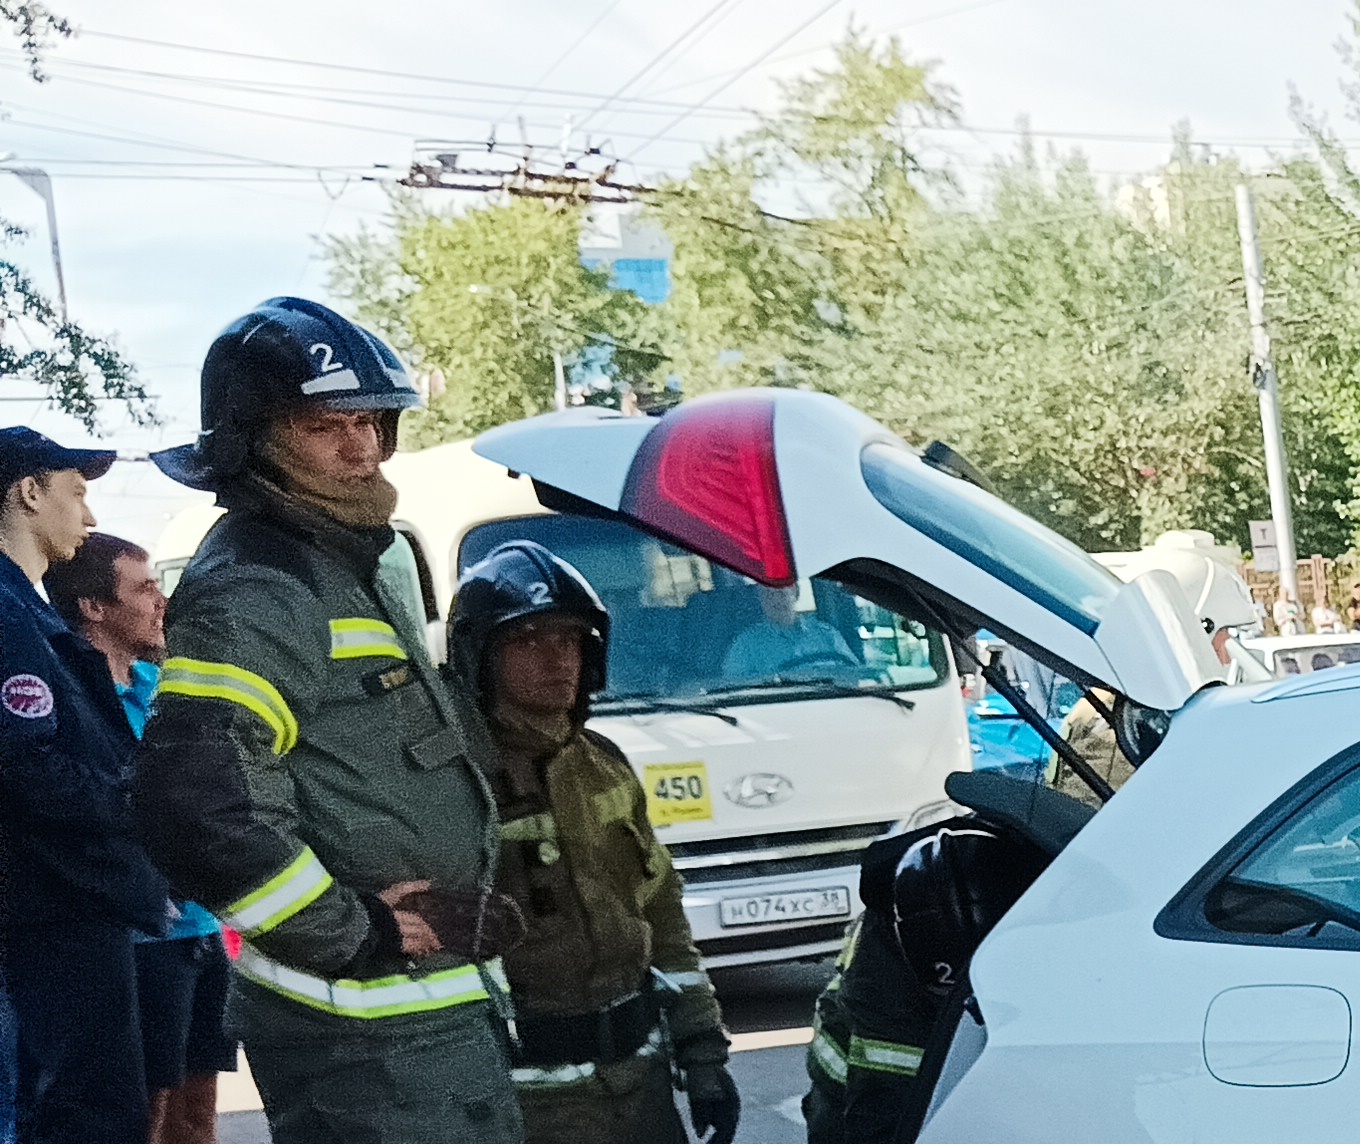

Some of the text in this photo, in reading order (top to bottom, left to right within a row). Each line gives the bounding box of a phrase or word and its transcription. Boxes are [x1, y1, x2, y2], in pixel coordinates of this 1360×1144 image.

[309, 343, 343, 372] 2
[528, 582, 553, 605] 2
[654, 775, 703, 801] 450
[935, 962, 955, 984] 2
